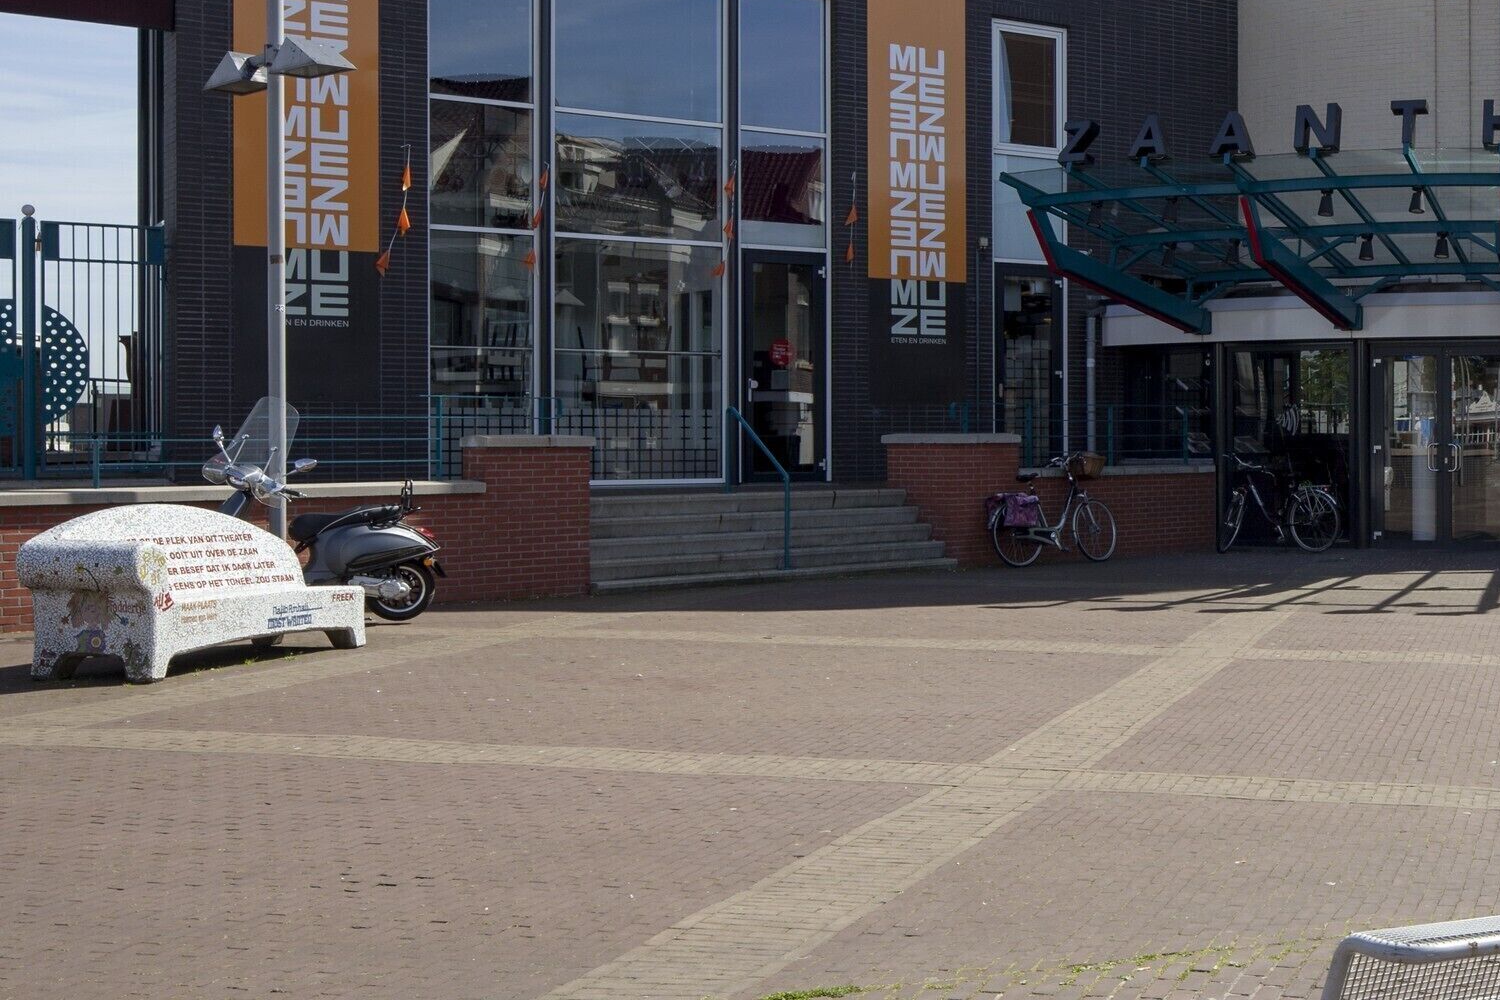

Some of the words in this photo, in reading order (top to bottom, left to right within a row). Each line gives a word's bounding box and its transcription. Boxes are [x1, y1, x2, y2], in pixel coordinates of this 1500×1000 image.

[294, 318, 307, 326] EN
[309, 319, 349, 328] DRINKEN
[919, 337, 947, 345] DRINKEN
[166, 536, 187, 545] PLEK
[187, 535, 204, 544] VAN
[218, 533, 253, 543] THEATER
[169, 551, 188, 560] OOIT
[190, 550, 203, 559] UIT
[205, 549, 226, 558] OVER
[238, 547, 258, 555] ZAAN
[181, 566, 204, 575] BESEF
[207, 565, 220, 573] DAT
[222, 564, 231, 572] IK
[232, 563, 252, 571] DAAR
[253, 561, 276, 569] LATER
[174, 581, 195, 591] EENS
[196, 581, 207, 589] OP
[209, 579, 223, 588] HET
[225, 577, 253, 587] TONEEL
[255, 576, 270, 584] ZOU
[272, 573, 295, 583] STAAN
[332, 593, 355, 602] FREEK
